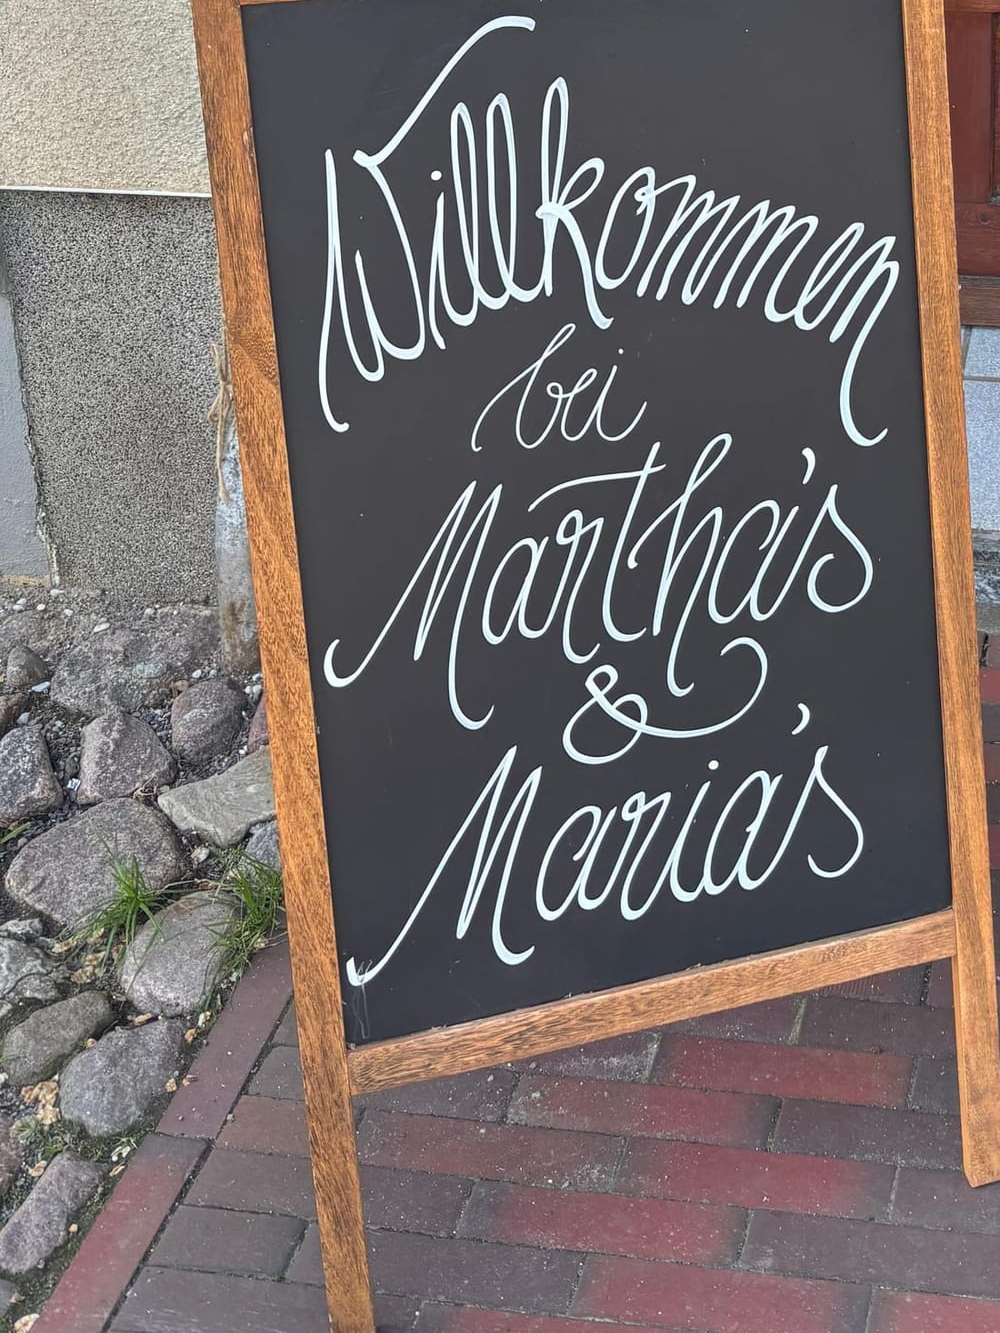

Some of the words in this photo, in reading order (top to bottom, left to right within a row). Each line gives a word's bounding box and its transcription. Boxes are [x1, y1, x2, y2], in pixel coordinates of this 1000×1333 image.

[318, 15, 900, 447] Willkommen
[470, 322, 648, 452] bei
[323, 433, 874, 730] Martha's
[562, 636, 768, 765] &
[346, 702, 864, 990] Maria's
